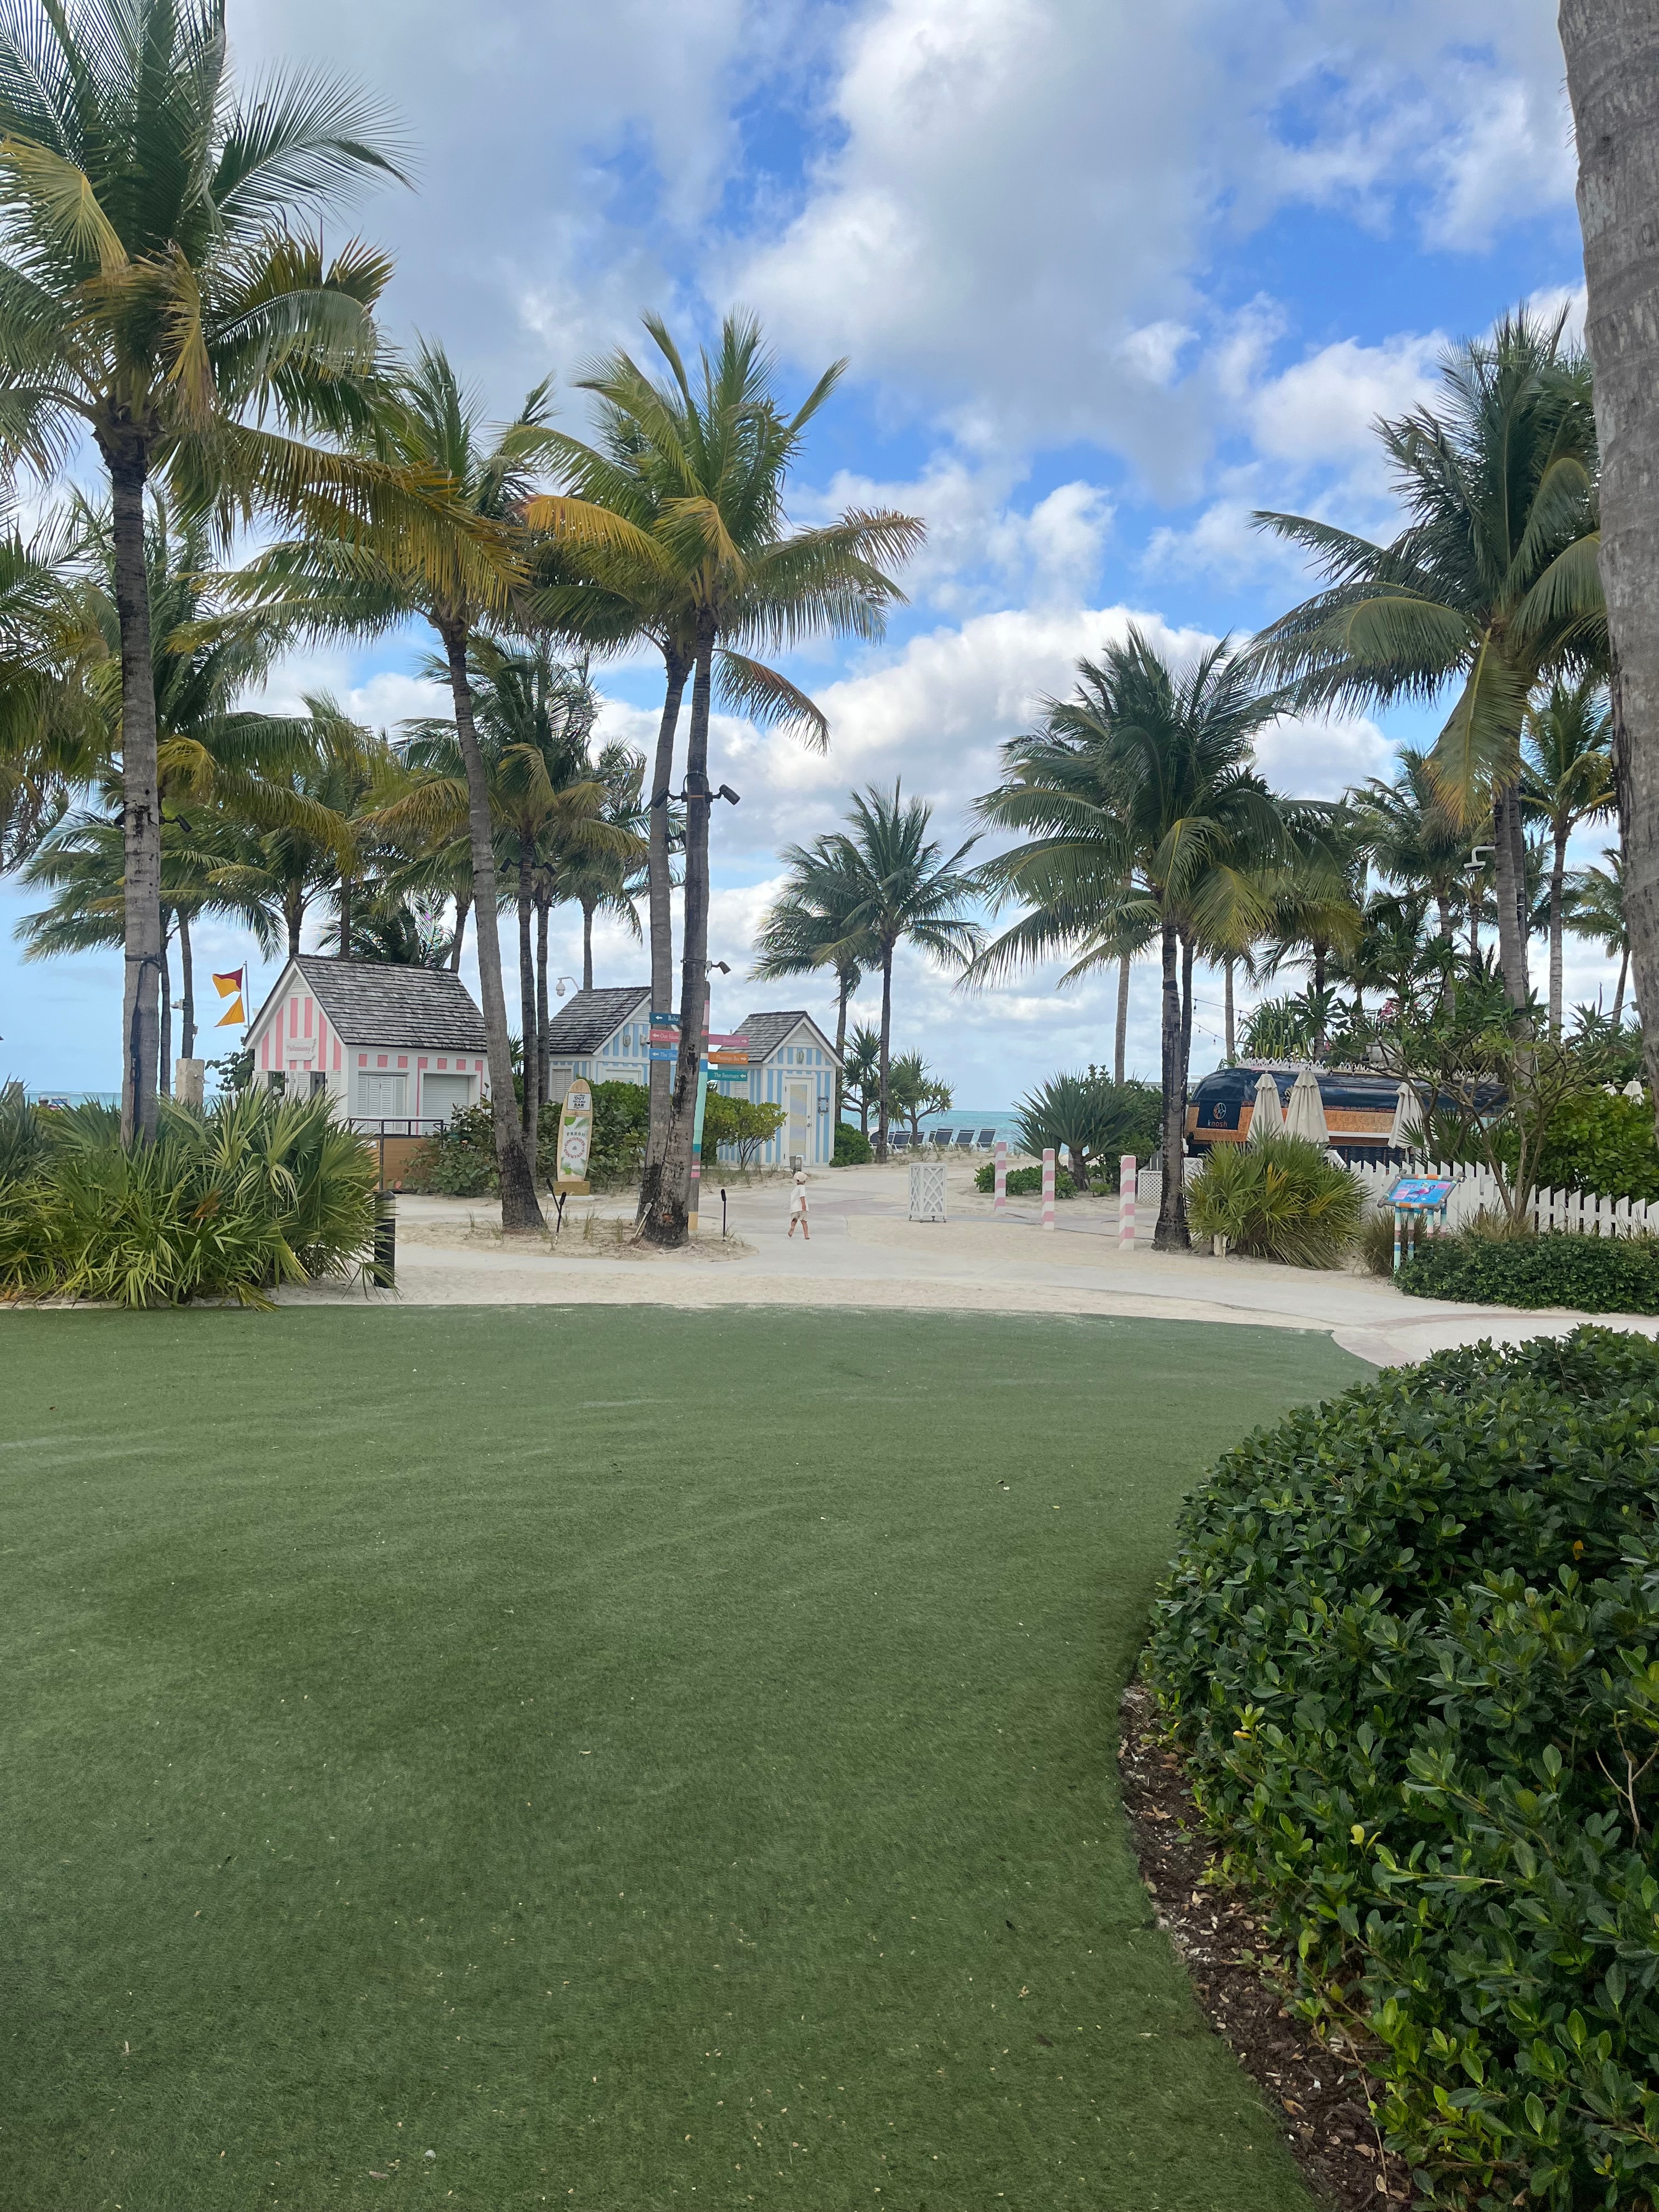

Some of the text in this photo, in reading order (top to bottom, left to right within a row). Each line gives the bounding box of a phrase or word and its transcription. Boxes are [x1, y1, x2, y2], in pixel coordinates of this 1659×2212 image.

[1207, 1119, 1228, 1127] knosh
[564, 1137, 585, 1147] COCONUTS
[563, 1149, 585, 1159] COCKTAILS
